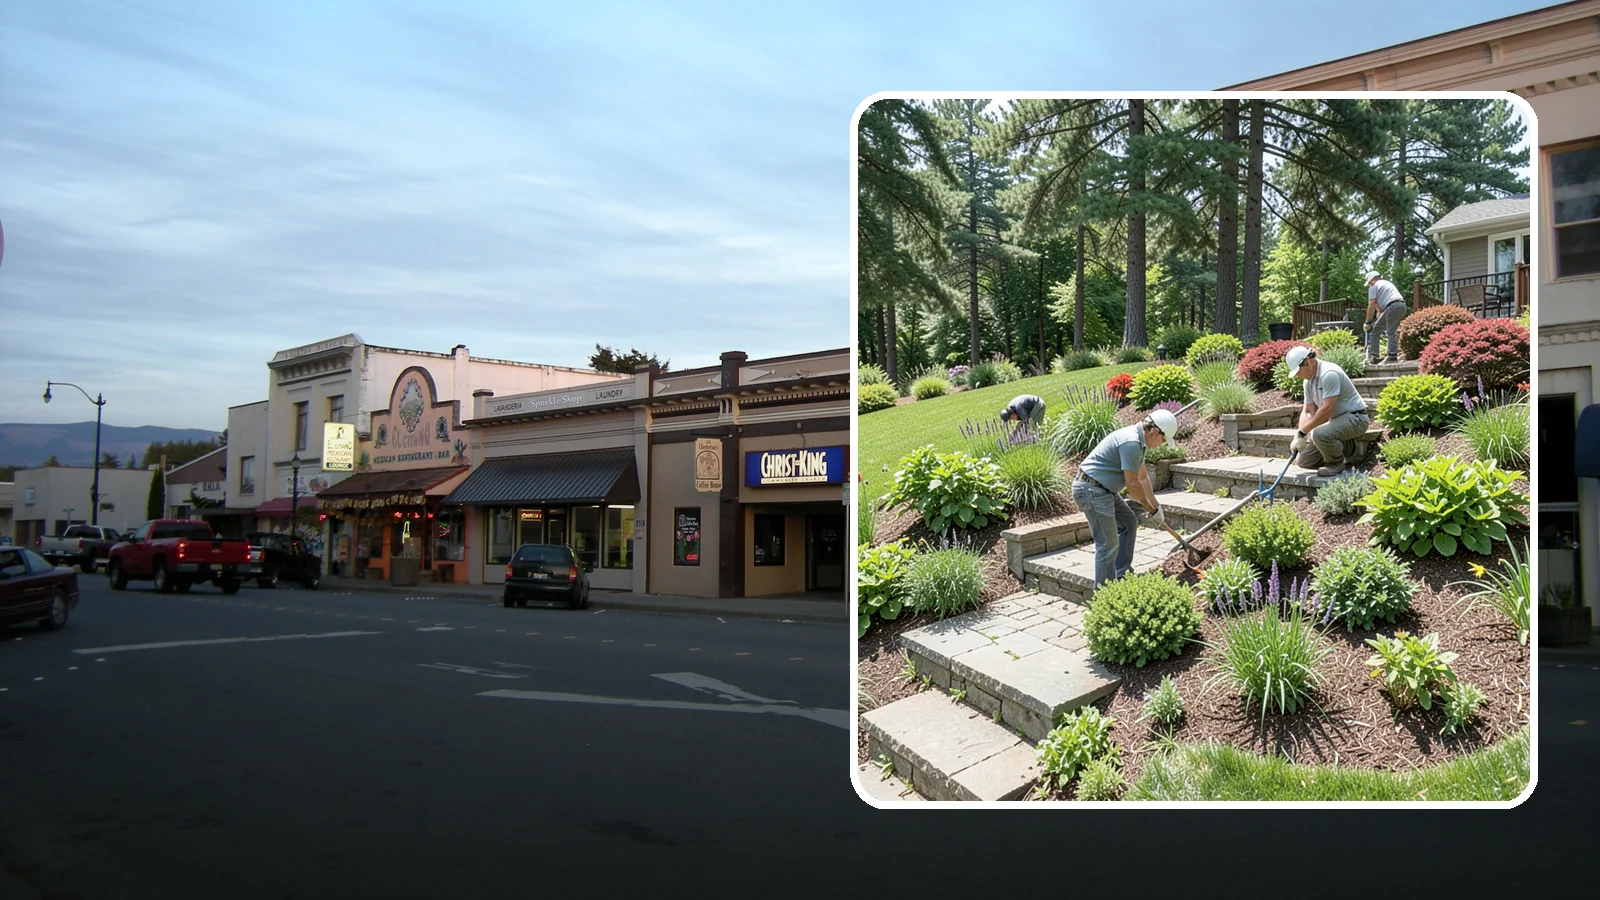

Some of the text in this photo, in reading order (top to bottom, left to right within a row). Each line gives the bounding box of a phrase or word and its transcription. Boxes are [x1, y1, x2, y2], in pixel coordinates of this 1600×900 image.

[494, 389, 623, 412] LAVANDERIA Sparkle Shop LAUNDRY
[373, 454, 396, 464] MEXICAN
[397, 451, 433, 462] RESTAURANT
[438, 450, 450, 459] BAR
[761, 450, 827, 478] CHRIST KING
